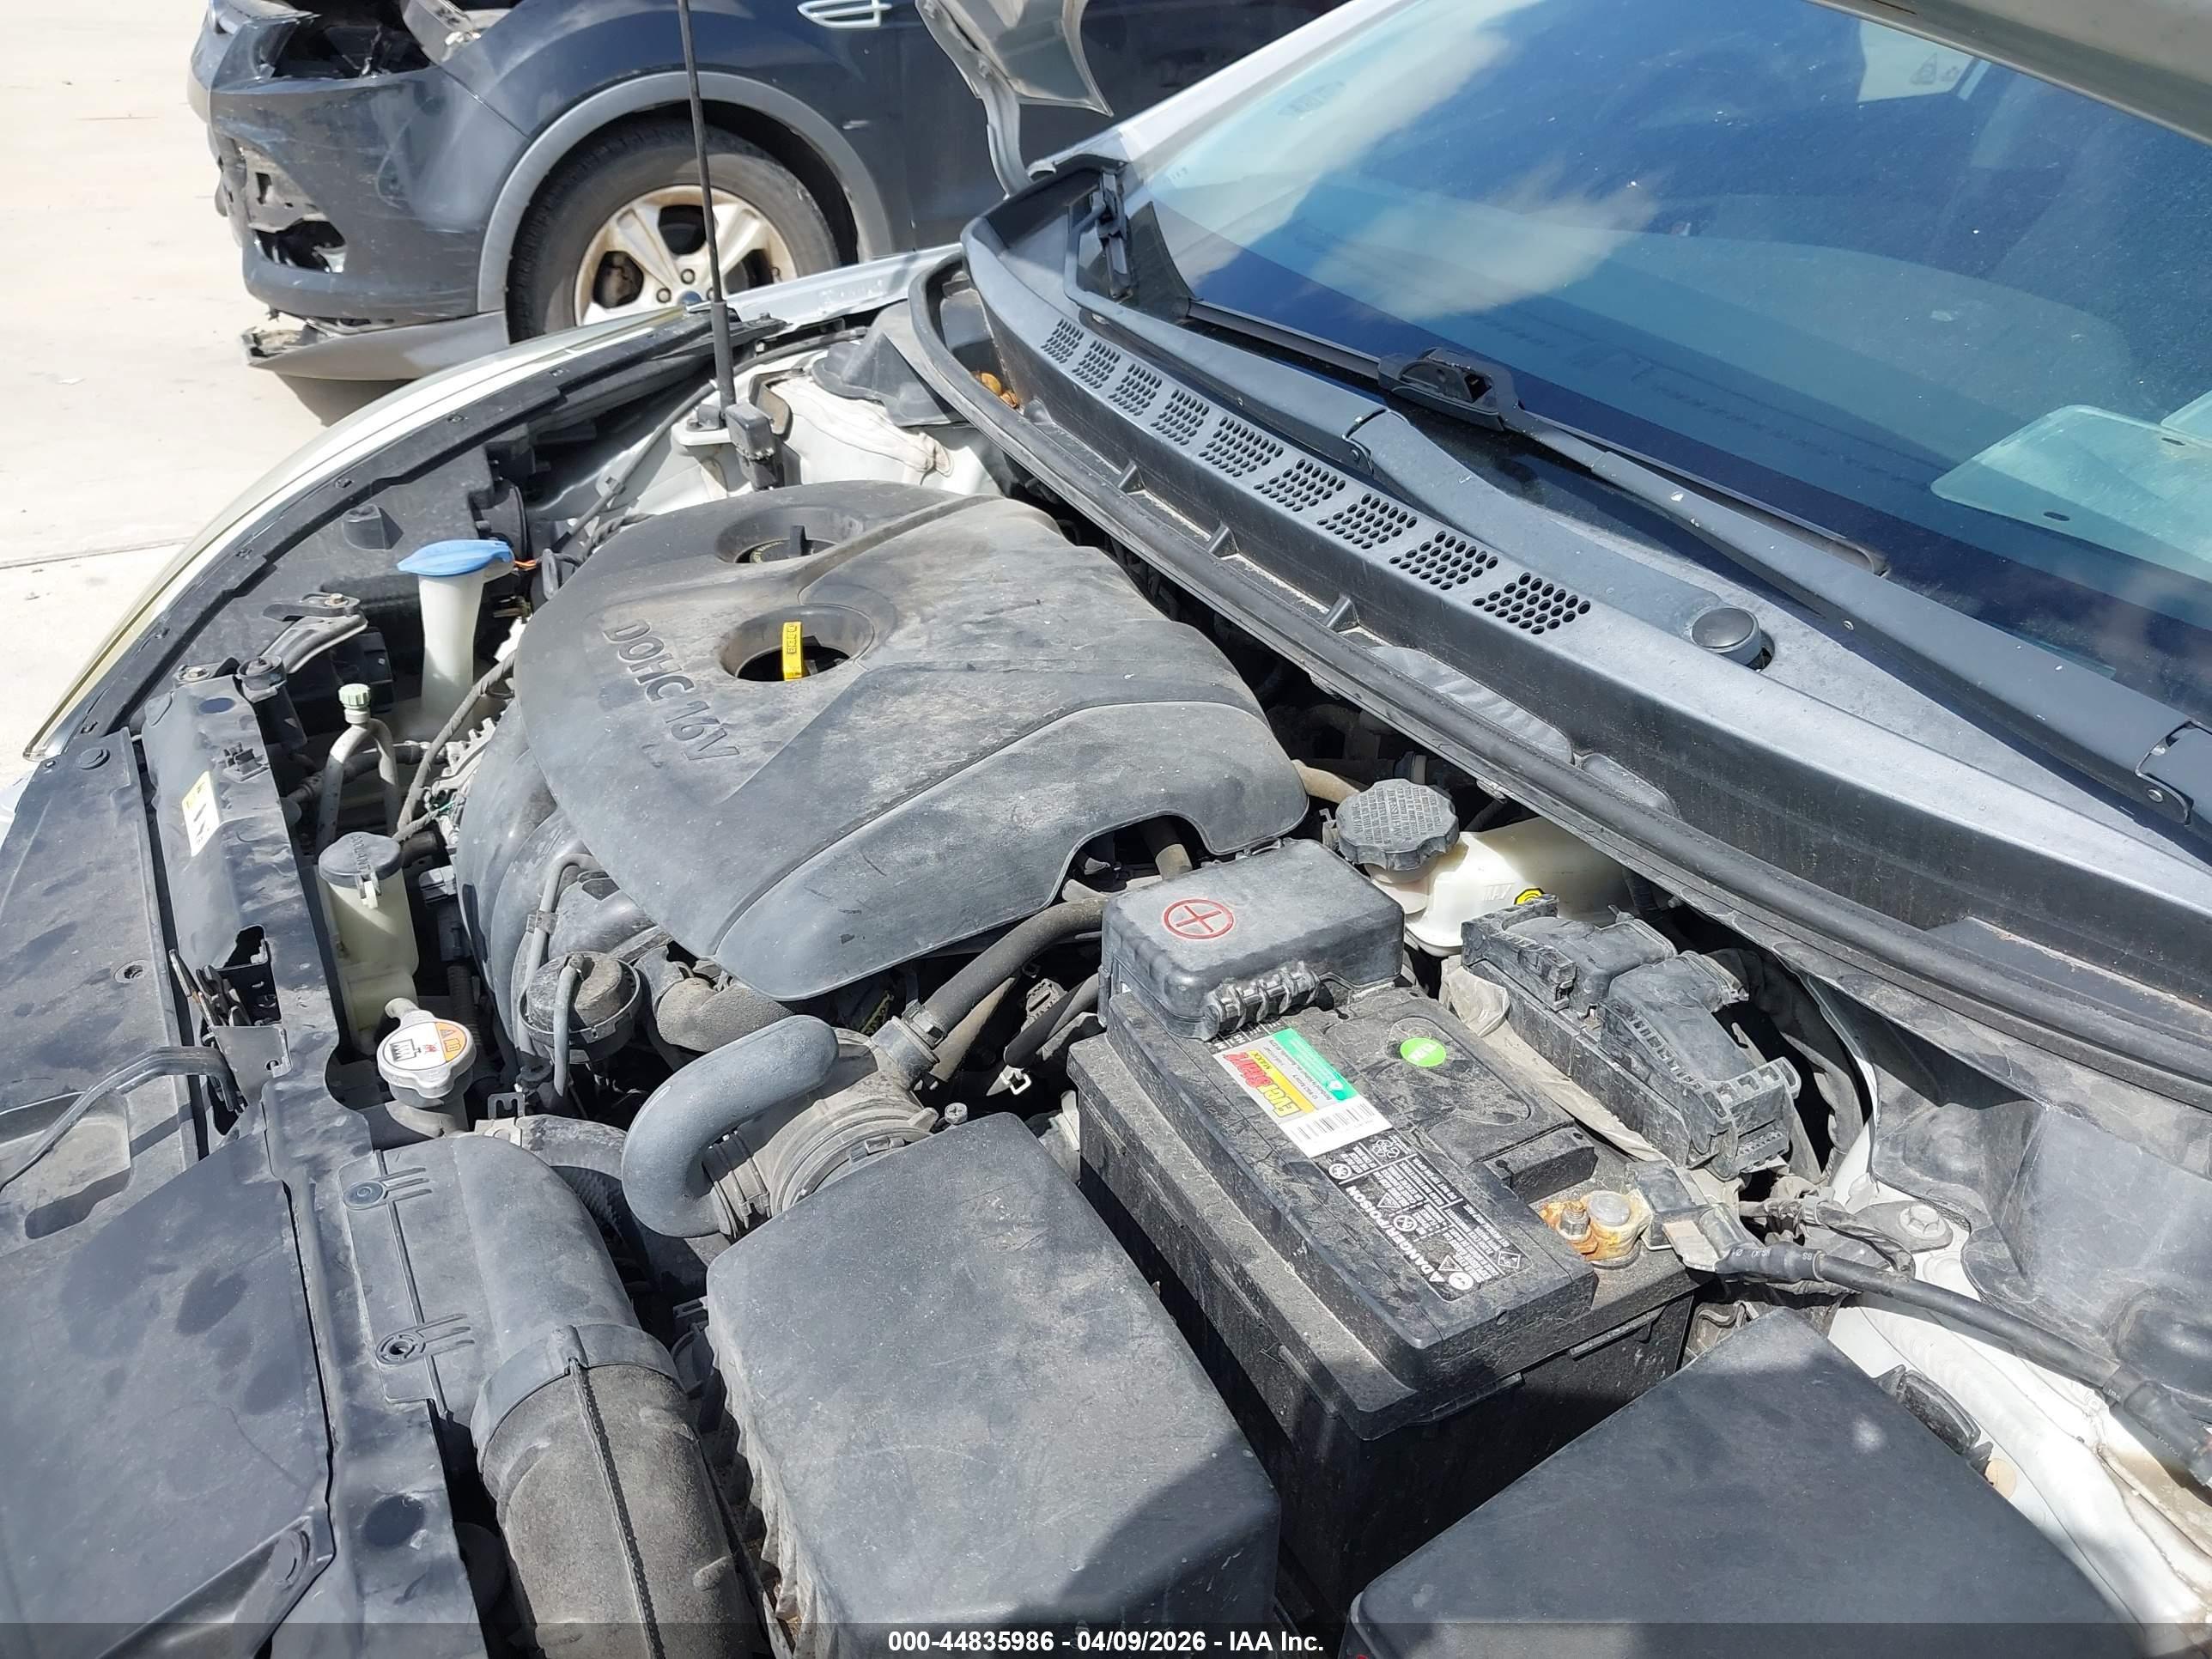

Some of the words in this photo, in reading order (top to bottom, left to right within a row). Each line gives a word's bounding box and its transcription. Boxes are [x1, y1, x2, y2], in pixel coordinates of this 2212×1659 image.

[603, 618, 696, 704] DOHC
[664, 701, 741, 763] 16V
[350, 835, 371, 872] COOLANT
[1220, 1048, 1302, 1119] EverStart
[1250, 1051, 1273, 1070] MAXX
[1343, 1184, 1437, 1274] DANGER/POISON
